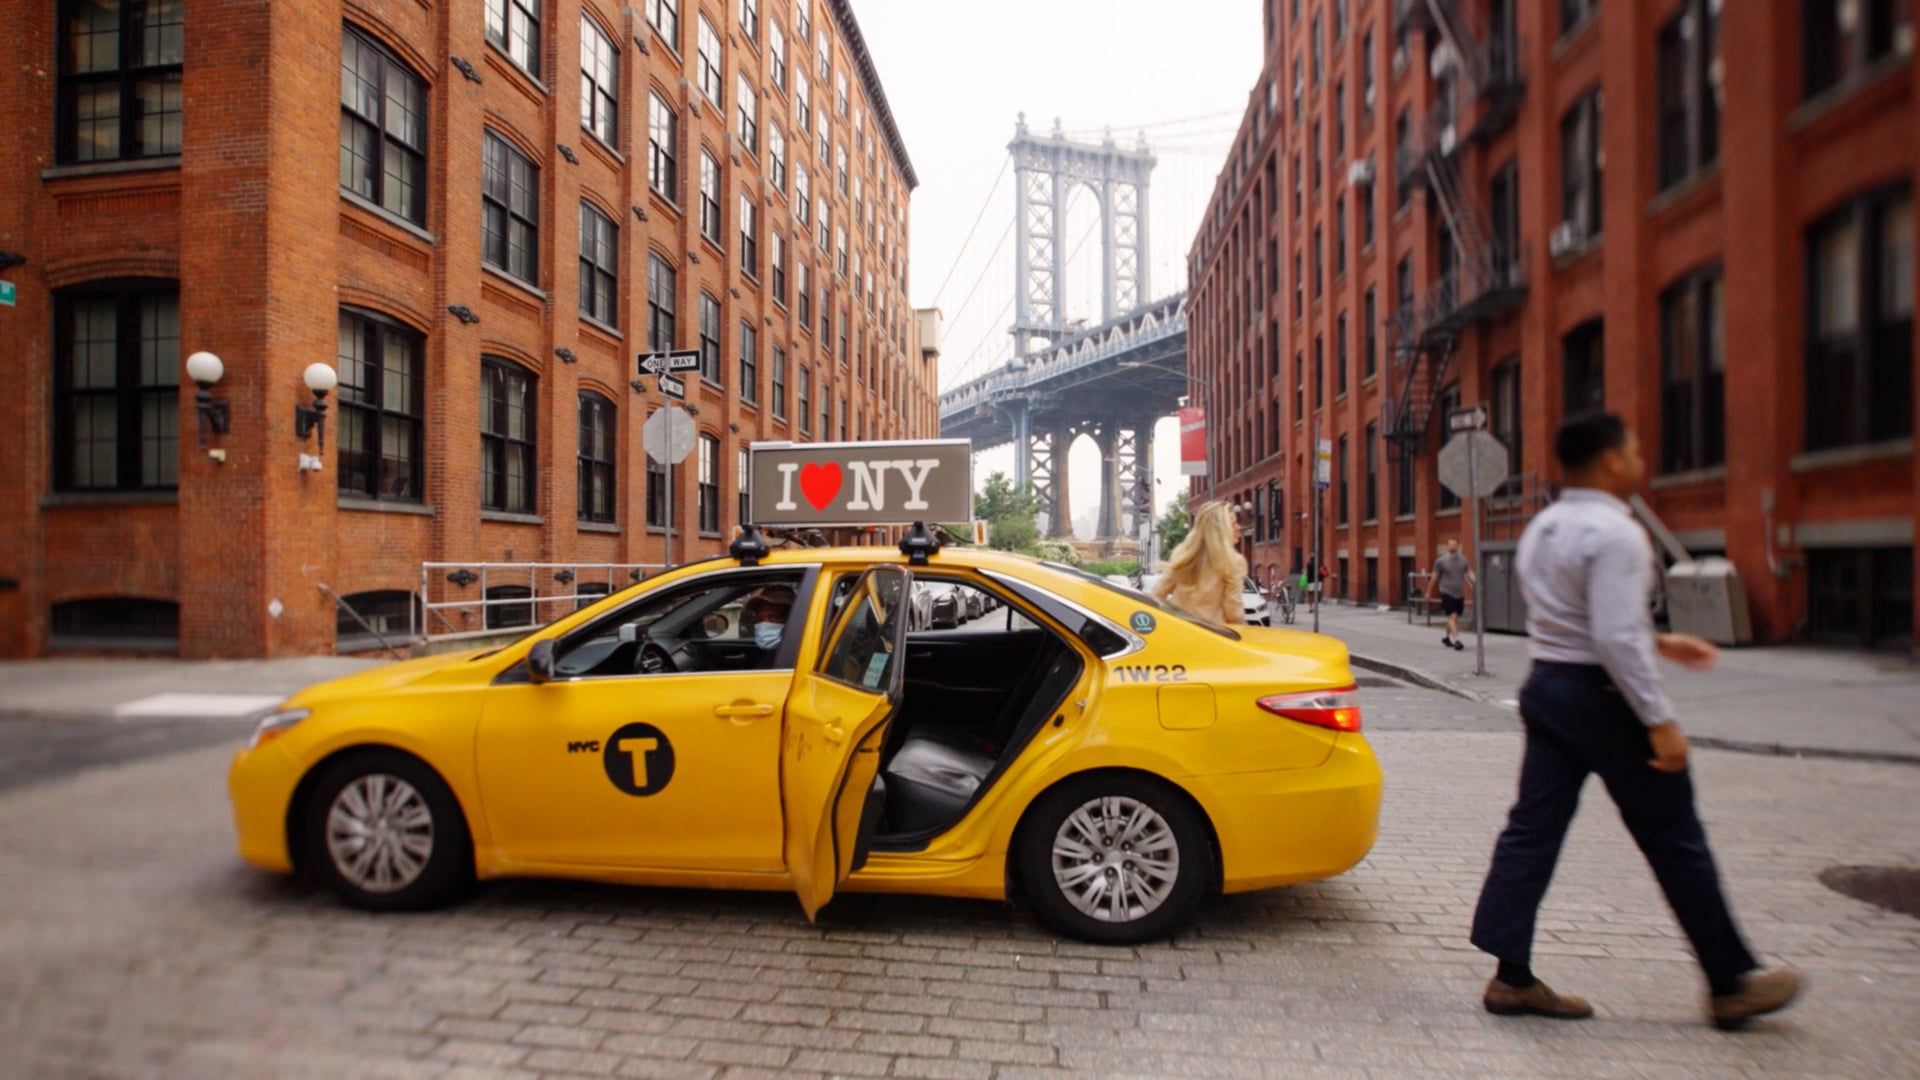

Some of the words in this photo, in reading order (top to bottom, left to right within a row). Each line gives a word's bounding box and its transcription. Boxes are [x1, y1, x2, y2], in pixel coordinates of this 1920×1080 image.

[647, 359, 665, 369] ONE
[673, 358, 692, 366] WAY
[775, 463, 799, 511] I
[846, 459, 940, 511] NY
[1113, 664, 1187, 682] 1W22
[567, 740, 600, 753] NYC
[618, 737, 658, 787] T
